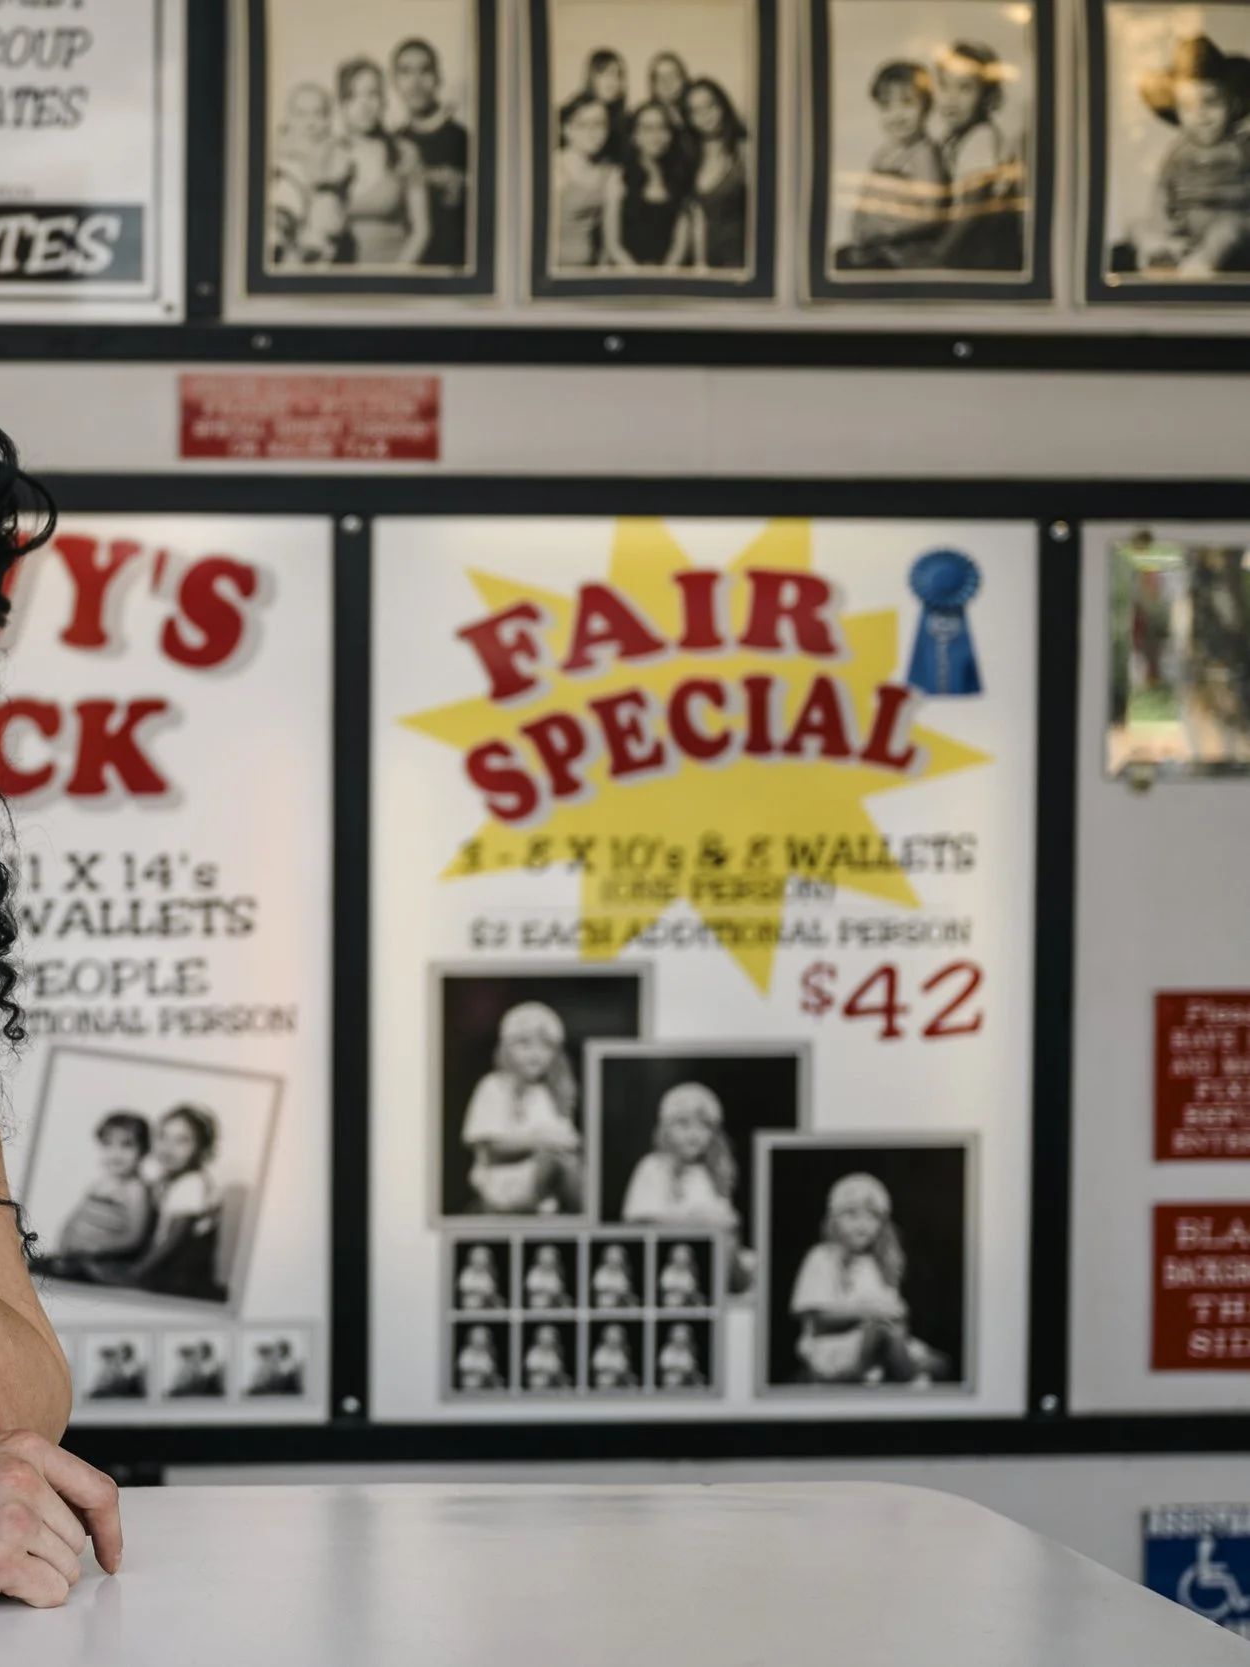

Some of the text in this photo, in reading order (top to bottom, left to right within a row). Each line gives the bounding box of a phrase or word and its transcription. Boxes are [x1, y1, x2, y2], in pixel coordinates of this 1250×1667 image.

[454, 566, 840, 705] FAIR
[463, 671, 920, 826] SPECIAL
[63, 851, 103, 893] X
[784, 830, 979, 873] WALLETS
[22, 956, 210, 999] EOPLE
[798, 958, 986, 1043] $42
